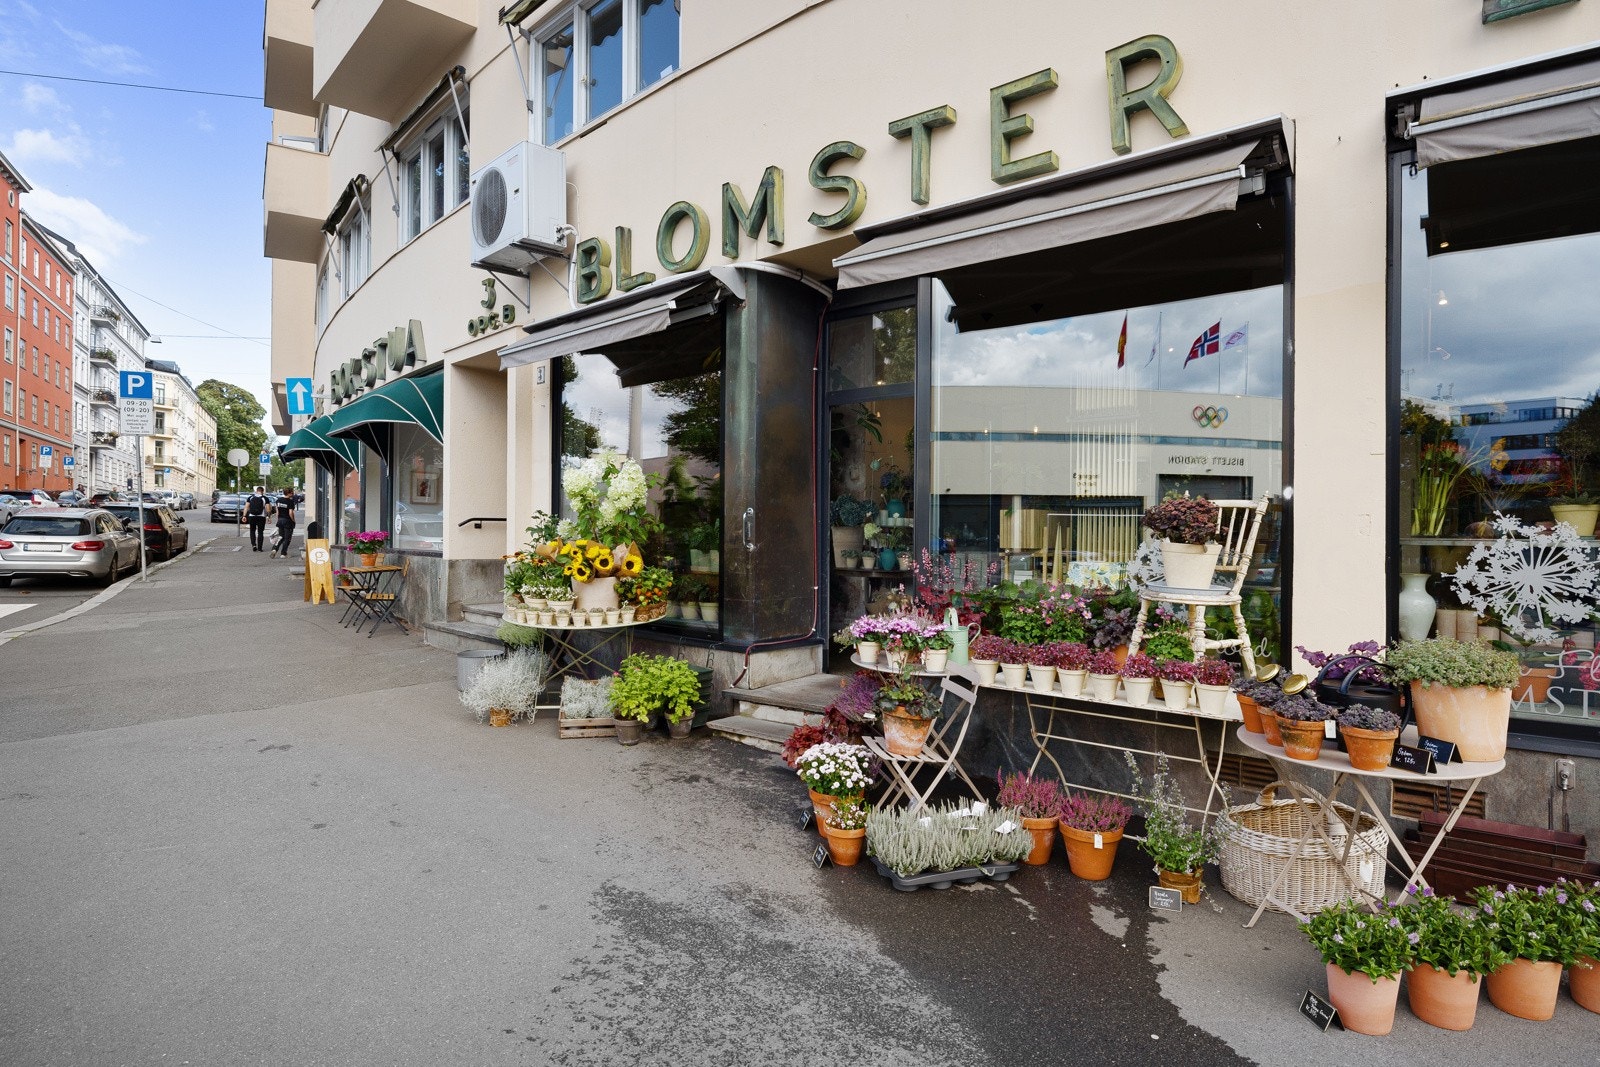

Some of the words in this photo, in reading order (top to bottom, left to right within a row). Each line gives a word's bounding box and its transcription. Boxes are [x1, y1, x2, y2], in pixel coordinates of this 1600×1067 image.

[576, 34, 1191, 304] BLOMSTER
[480, 277, 497, 310] 3
[330, 319, 427, 405] BOKSTUA
[127, 374, 145, 395] P
[42, 446, 50, 455] P
[65, 457, 72, 465] P
